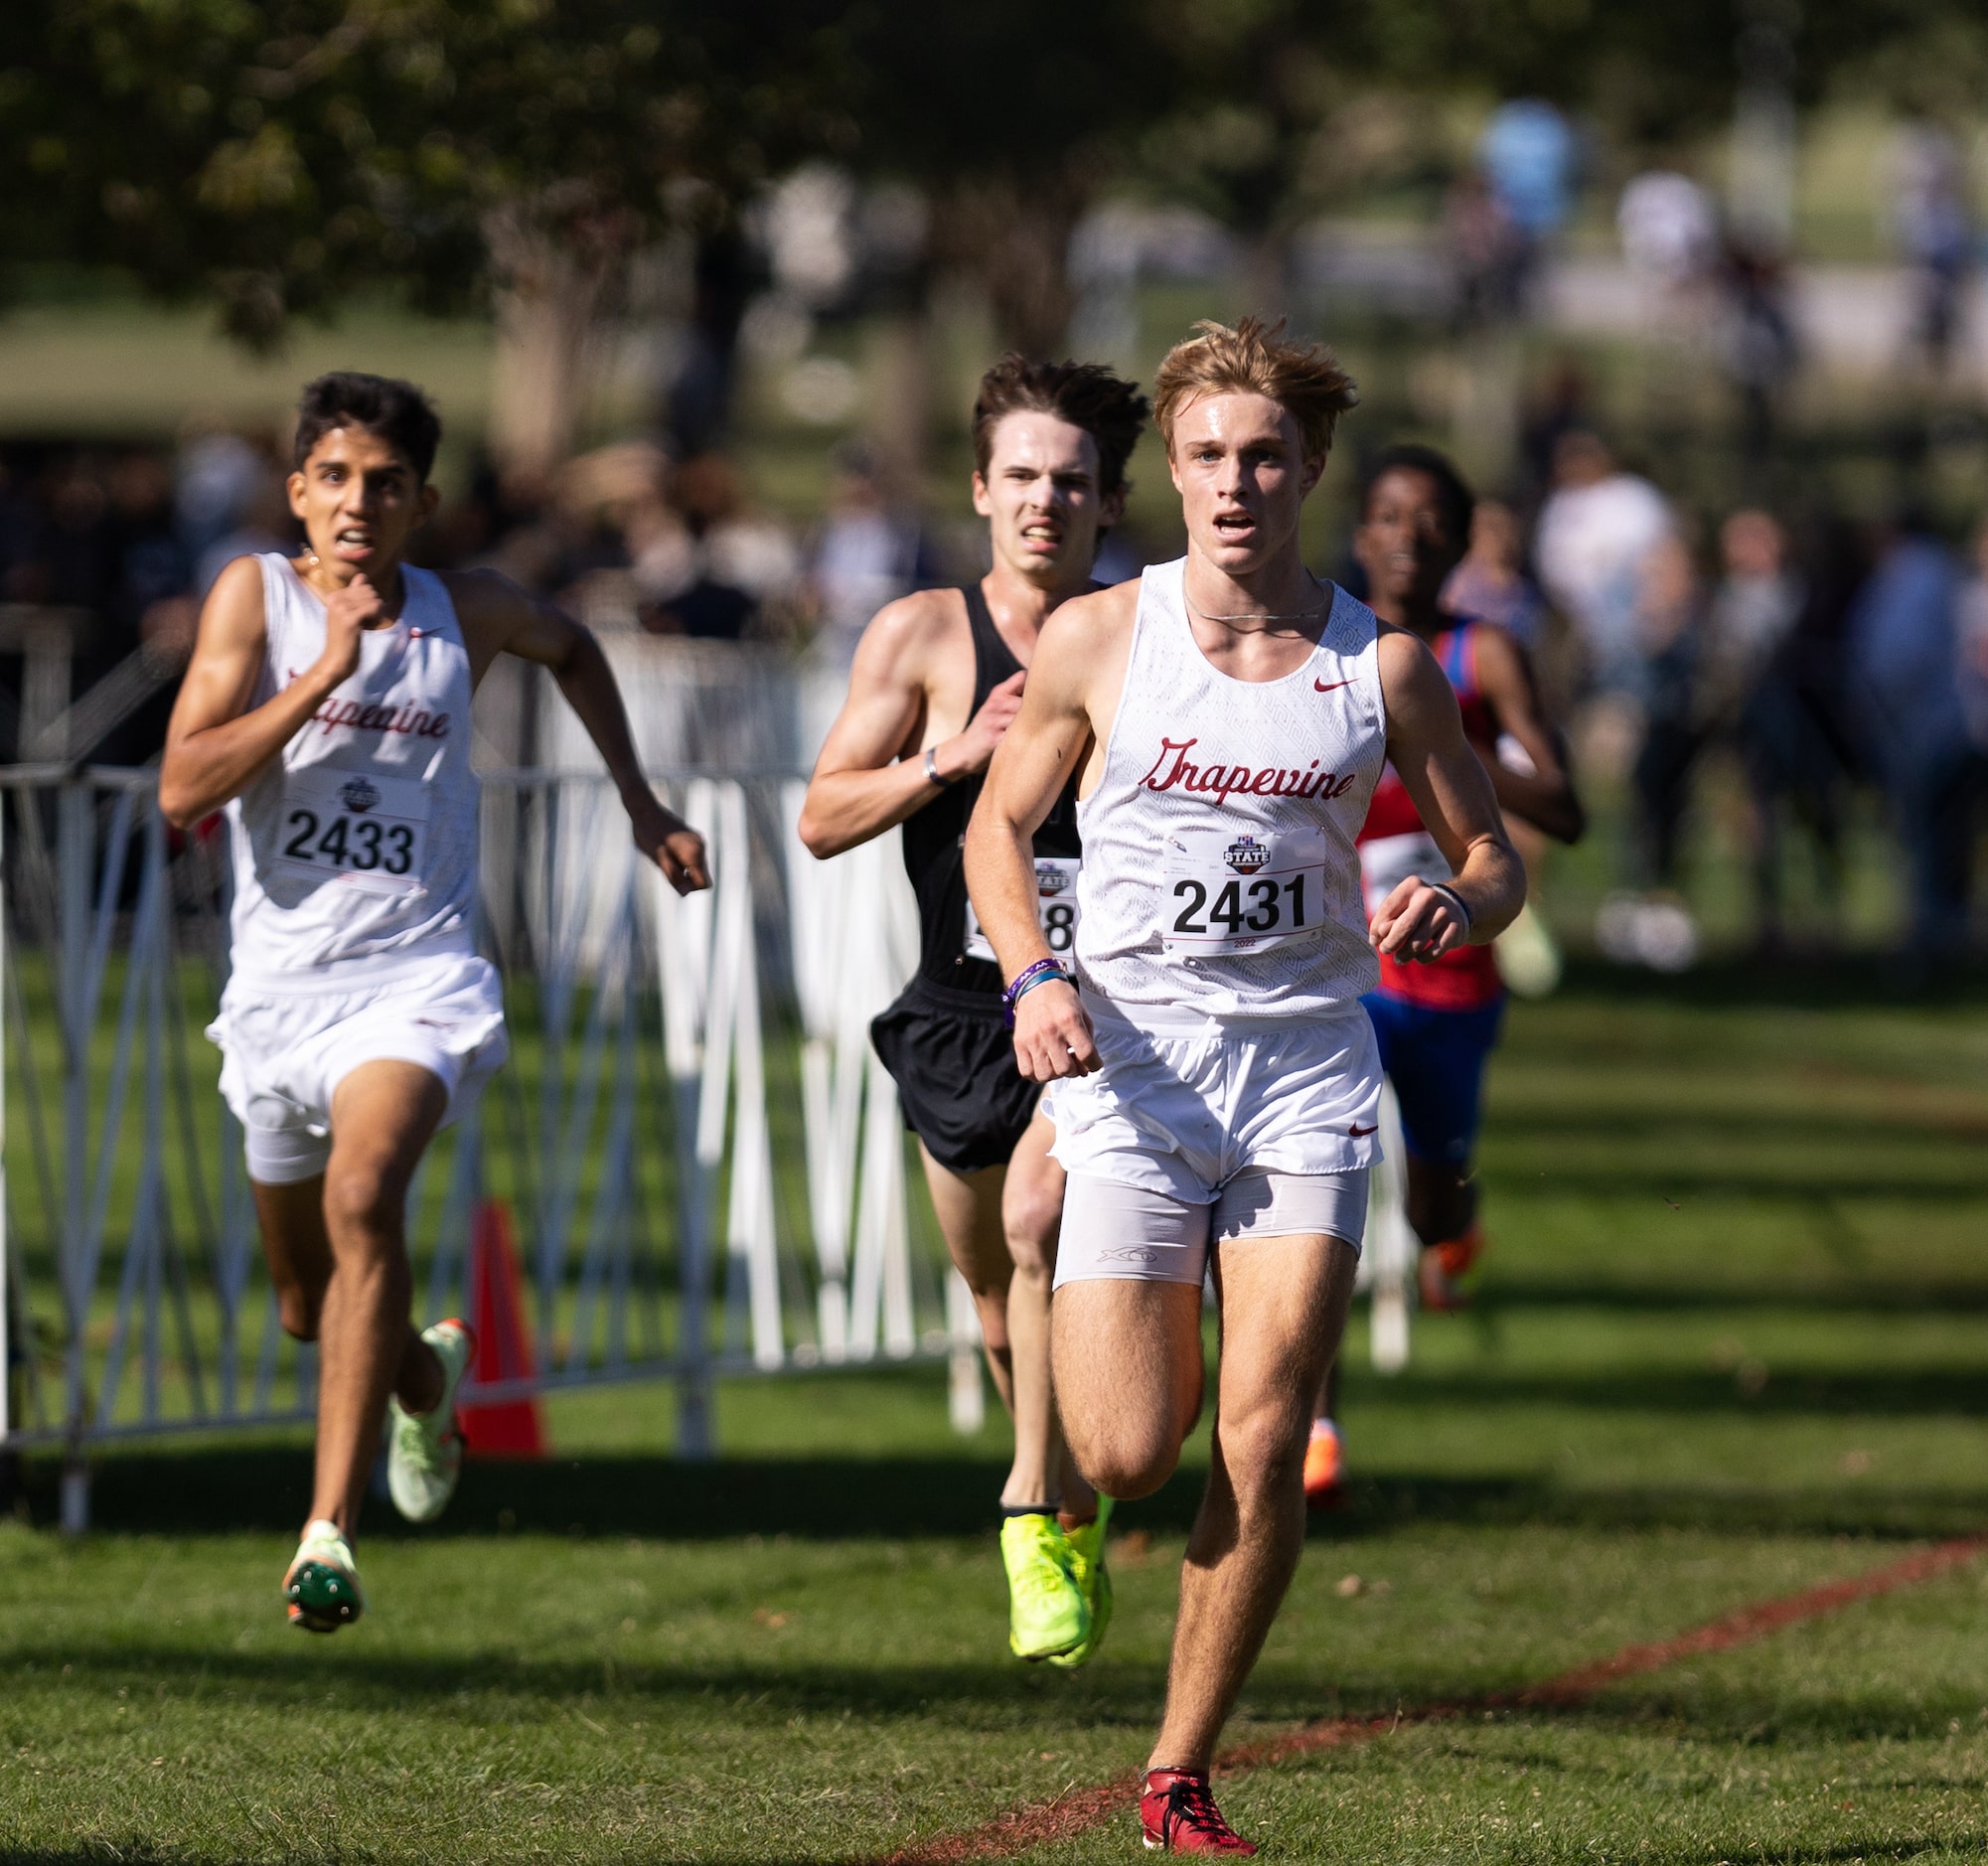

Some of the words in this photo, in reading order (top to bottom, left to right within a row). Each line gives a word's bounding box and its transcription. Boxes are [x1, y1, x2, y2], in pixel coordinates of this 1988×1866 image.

[1138, 736, 1355, 806] Grapevine
[284, 809, 414, 875] 2433
[1224, 852, 1269, 862] STATE
[1172, 873, 1305, 934] 2431
[1234, 938, 1256, 948] 2022
